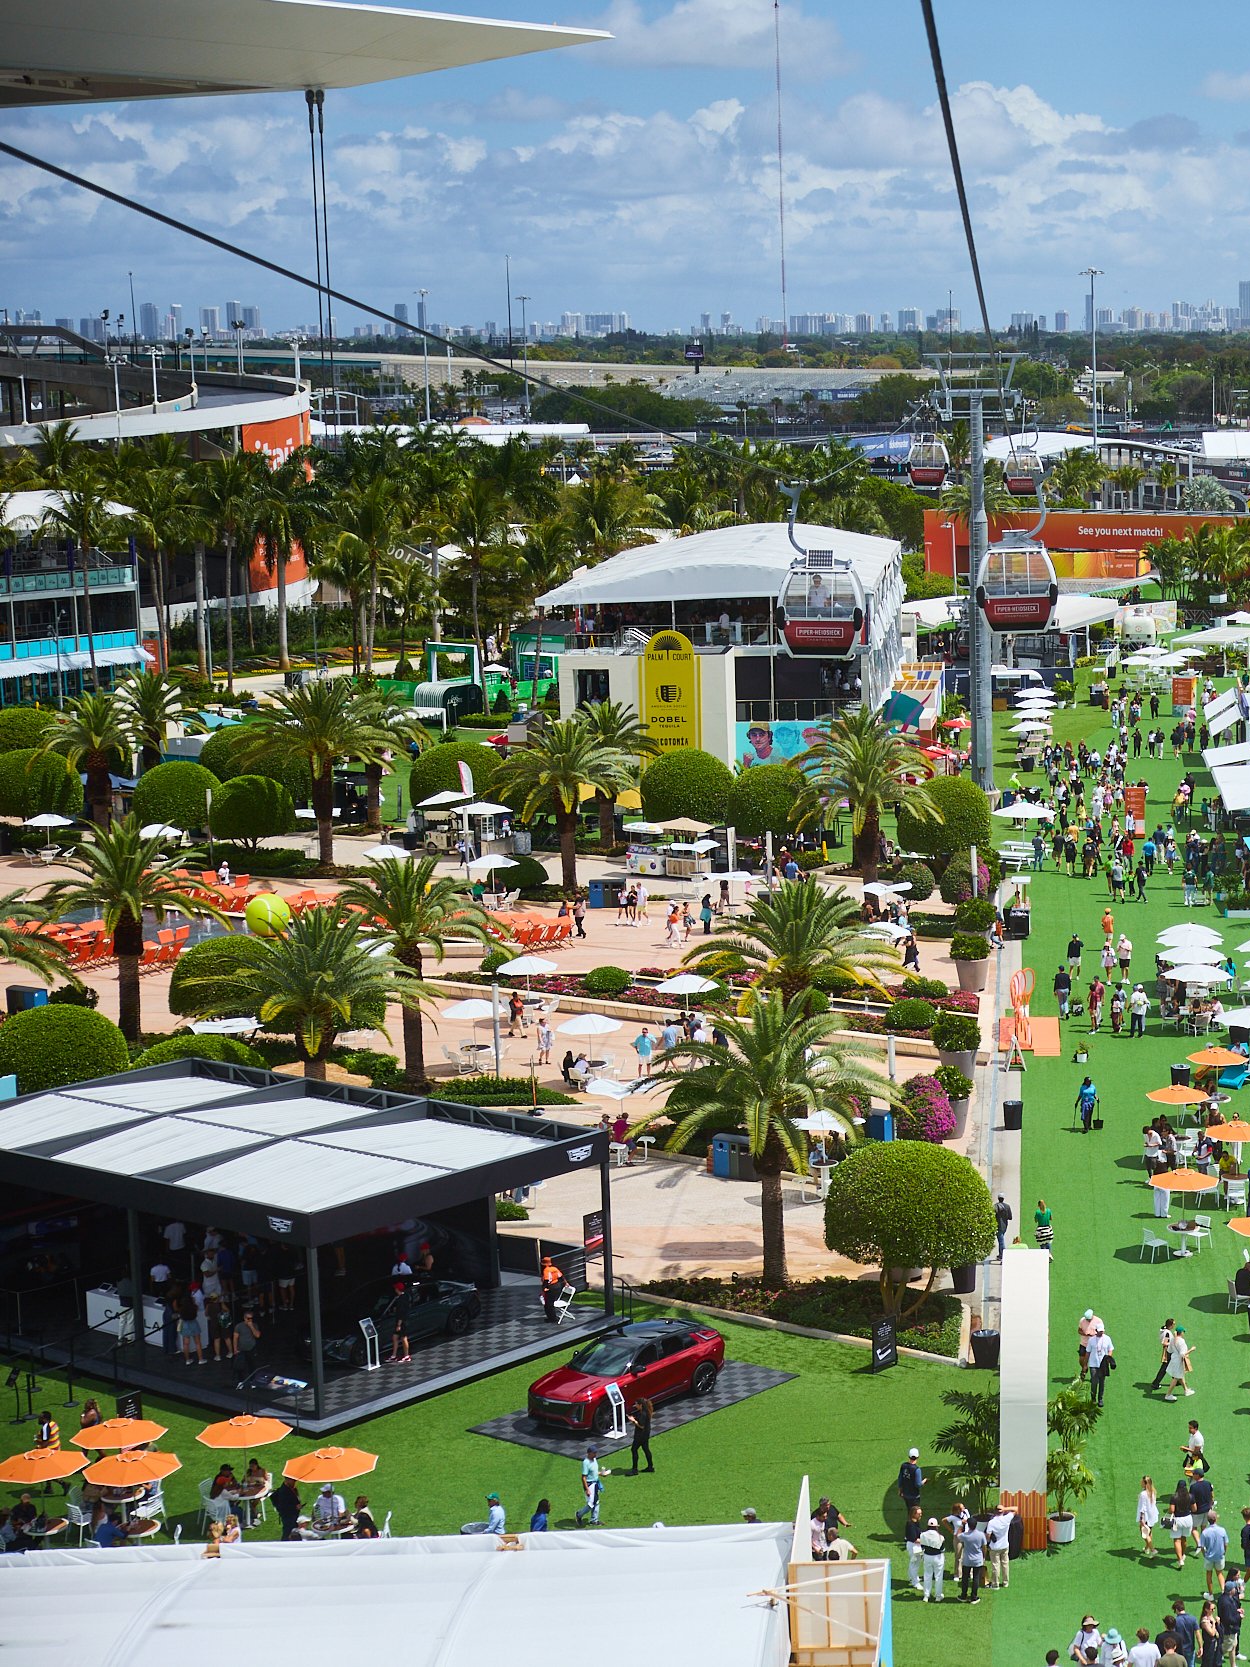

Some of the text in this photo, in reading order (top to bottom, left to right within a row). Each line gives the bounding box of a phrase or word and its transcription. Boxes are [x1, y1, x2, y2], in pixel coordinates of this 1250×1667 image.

[1078, 526, 1164, 537] See you next match!
